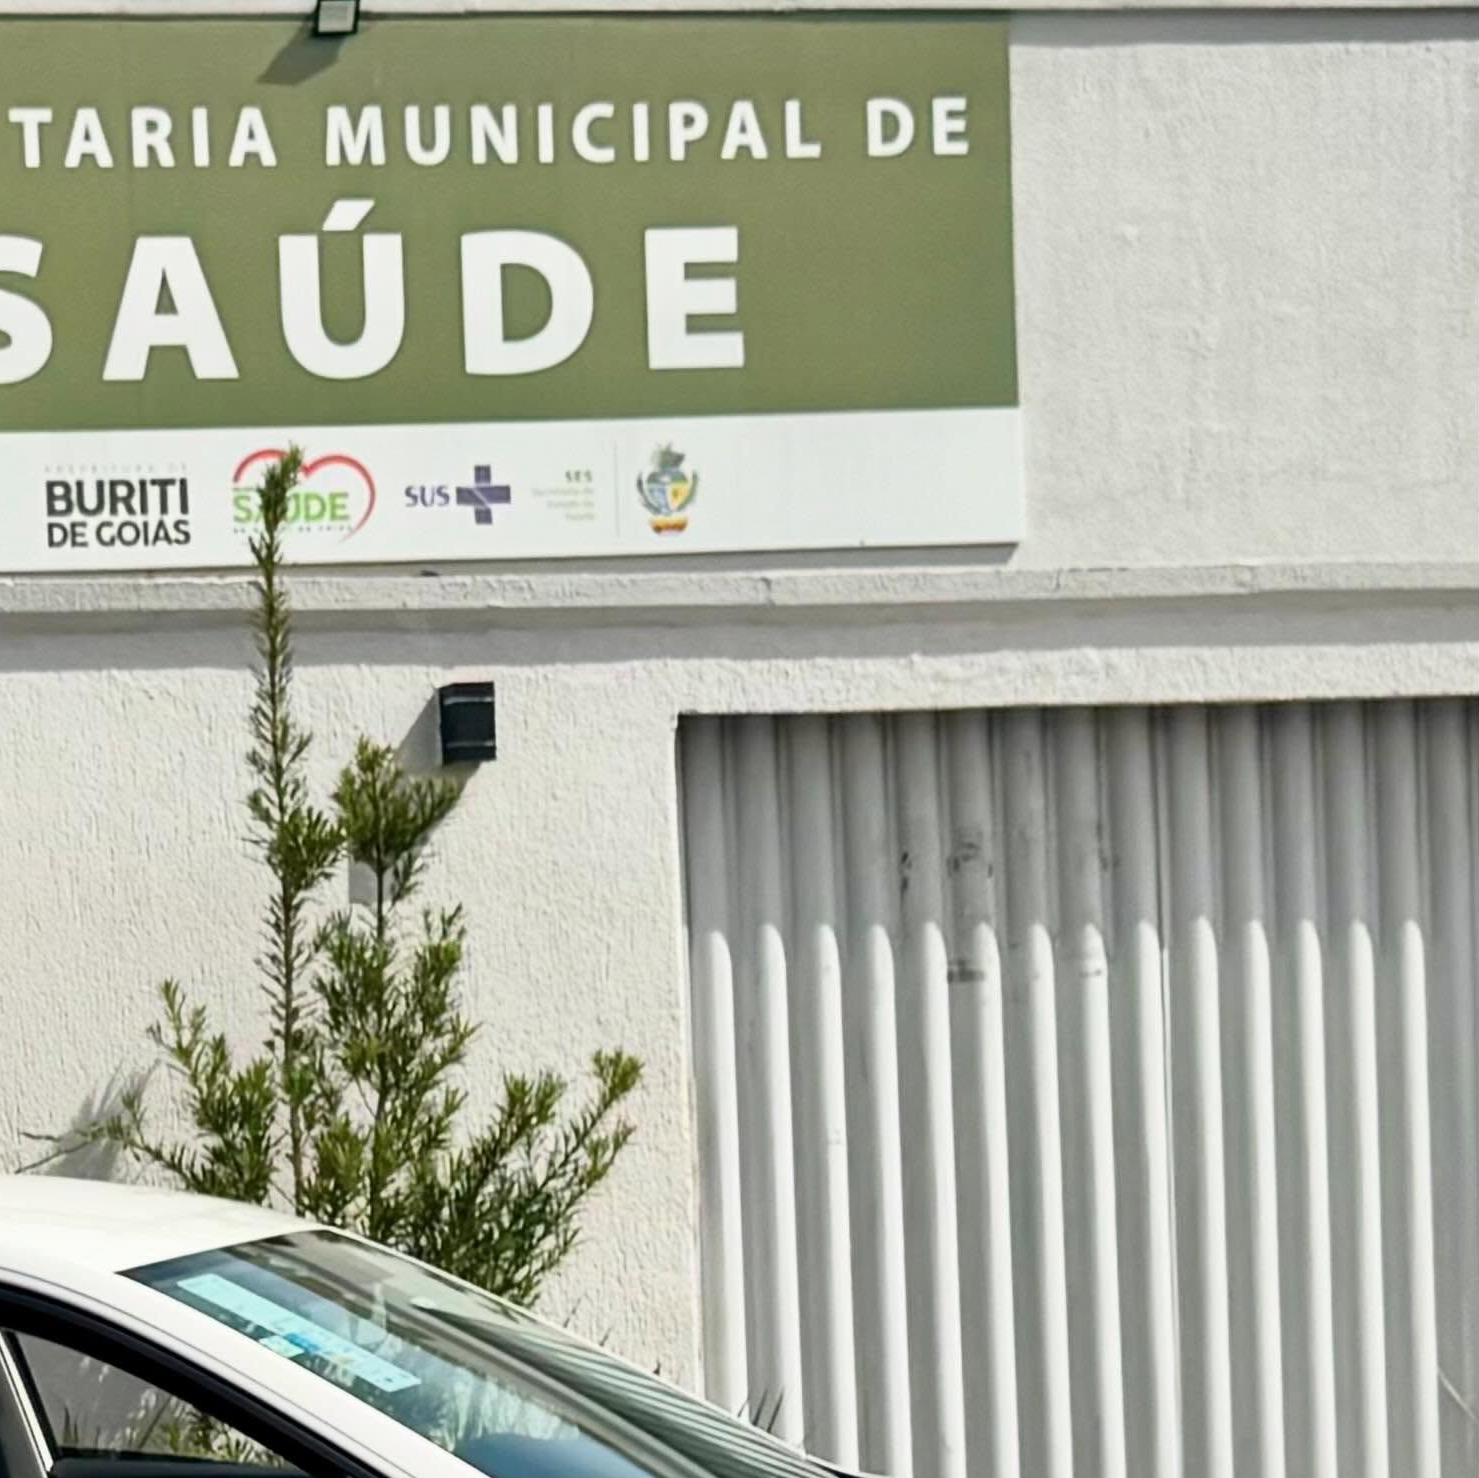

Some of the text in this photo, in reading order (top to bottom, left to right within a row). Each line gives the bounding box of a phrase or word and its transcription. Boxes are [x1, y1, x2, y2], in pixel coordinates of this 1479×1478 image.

[323, 97, 823, 168] MUNICIPAL
[866, 96, 971, 158] DE
[46, 478, 189, 517] BURITI
[404, 485, 450, 508] SUS
[47, 521, 89, 548] DE
